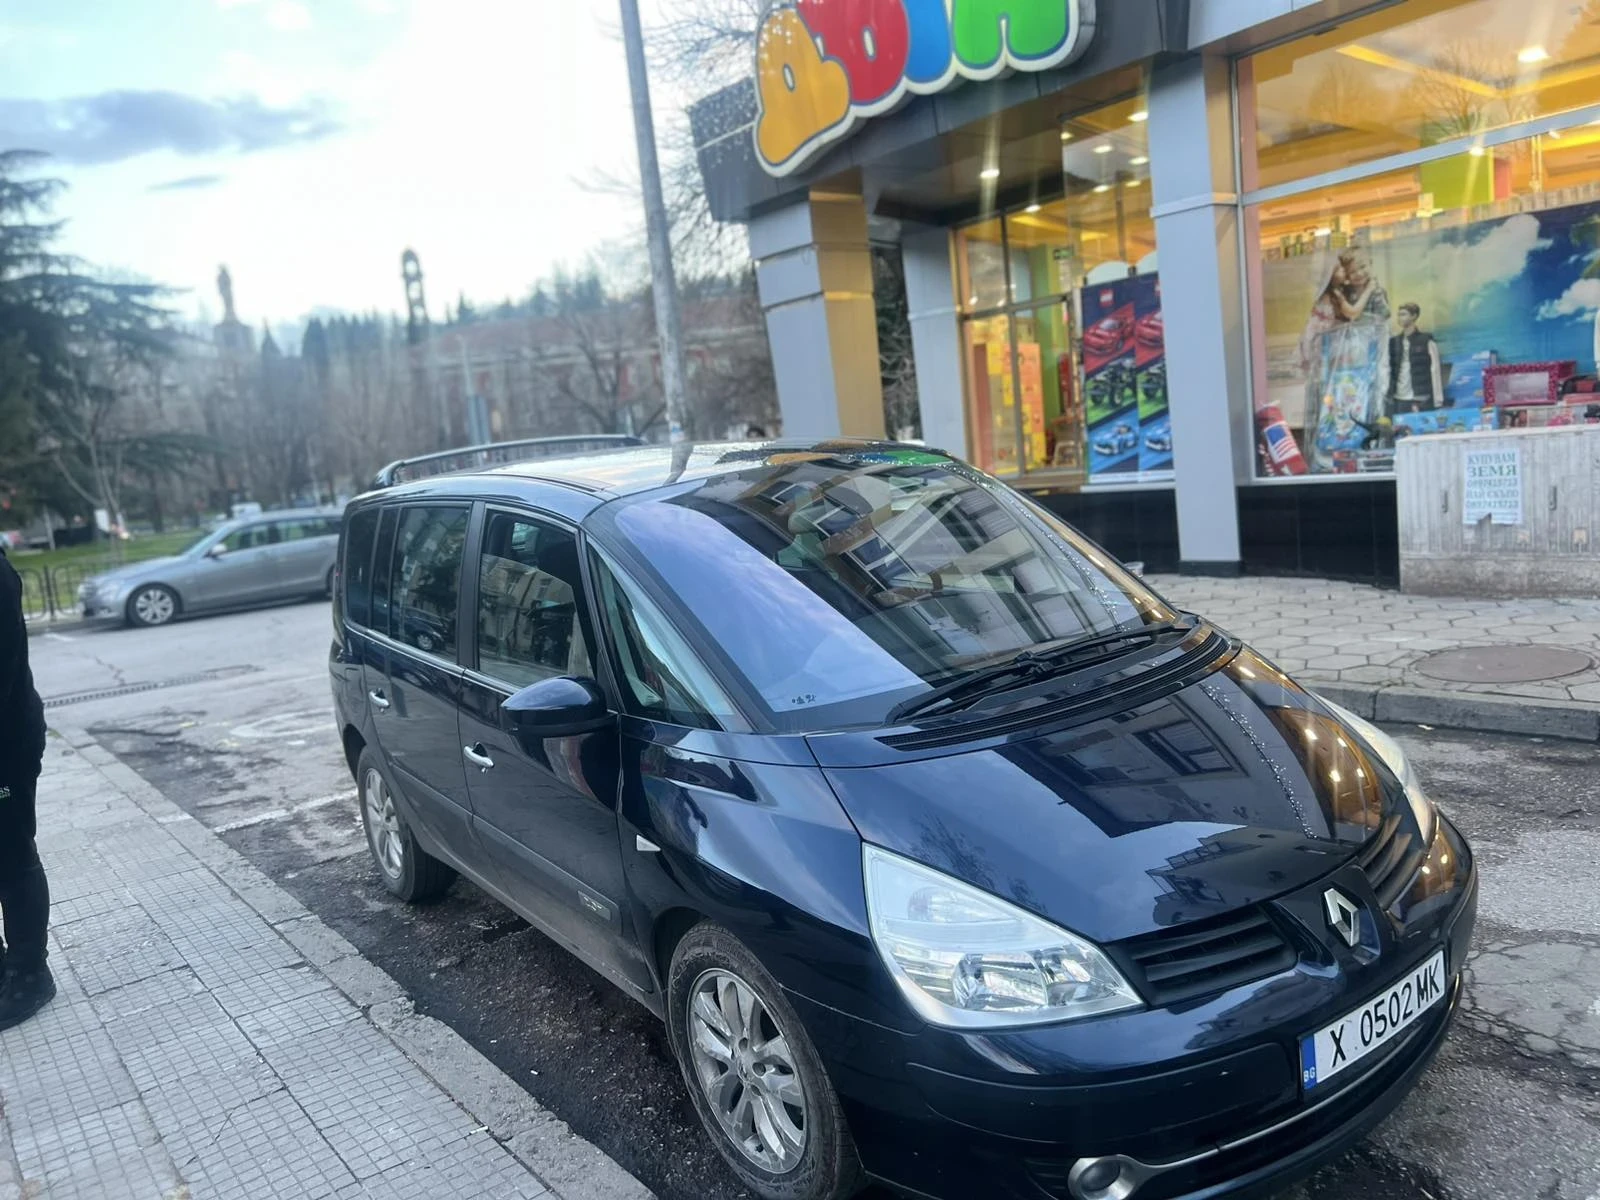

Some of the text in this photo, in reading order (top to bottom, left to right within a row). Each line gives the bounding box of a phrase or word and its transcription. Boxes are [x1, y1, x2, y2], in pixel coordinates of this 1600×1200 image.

[1468, 465, 1517, 477] ЗЕМЯ
[1330, 1024, 1346, 1068] X
[1303, 1067, 1316, 1083] BG
